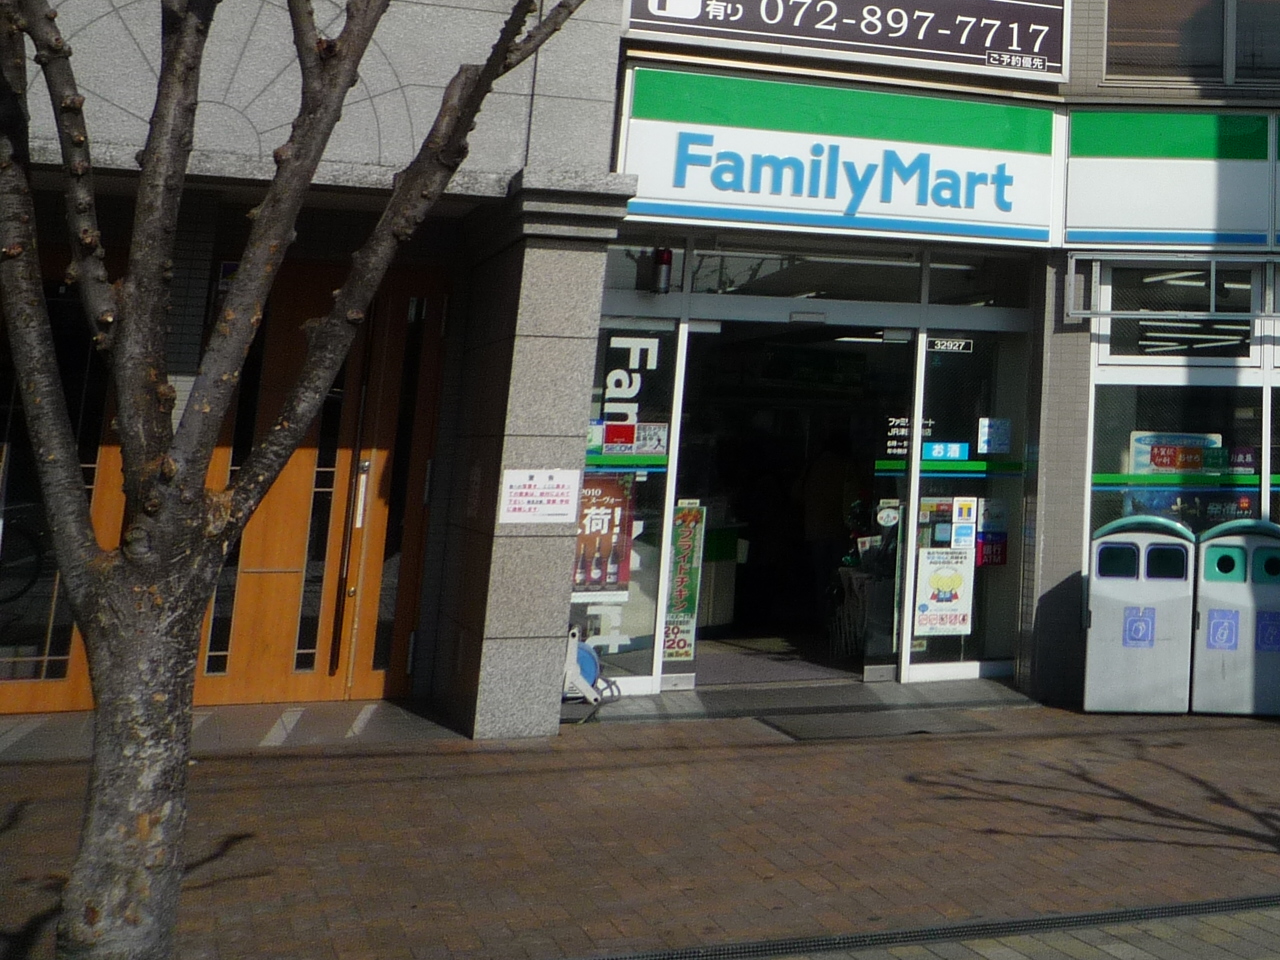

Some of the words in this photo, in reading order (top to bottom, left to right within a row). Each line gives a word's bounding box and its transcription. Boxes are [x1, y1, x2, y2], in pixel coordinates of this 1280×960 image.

[704, 0, 744, 21] 有り
[989, 54, 1044, 70] ご予約優先
[672, 131, 1014, 217] FamilyMart
[934, 340, 965, 350] 32927
[604, 444, 633, 452] SECOM
[931, 443, 960, 458] お酒
[577, 506, 621, 535] 荷!
